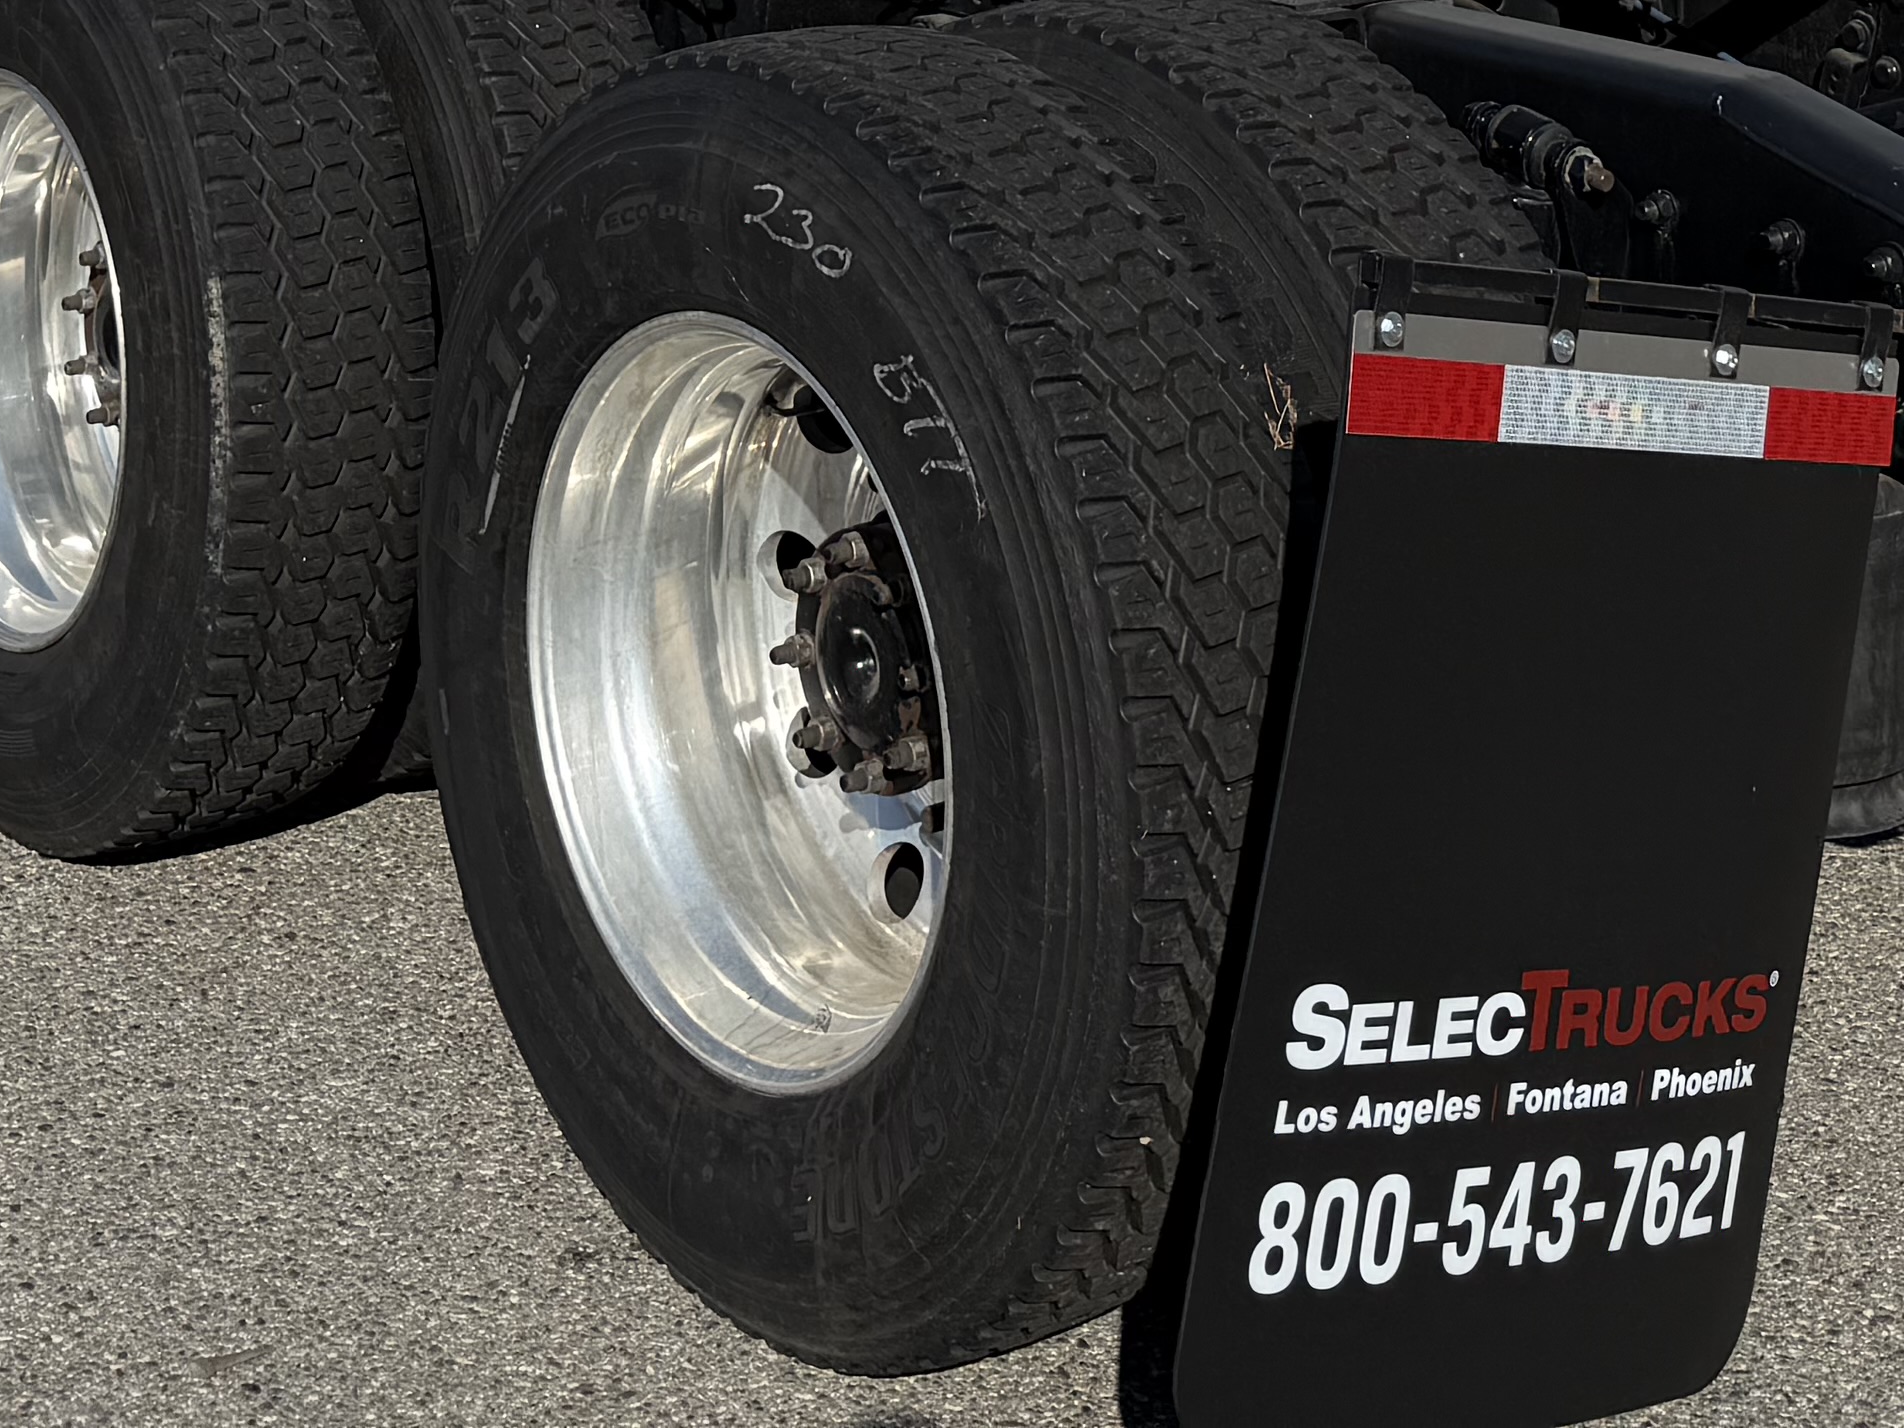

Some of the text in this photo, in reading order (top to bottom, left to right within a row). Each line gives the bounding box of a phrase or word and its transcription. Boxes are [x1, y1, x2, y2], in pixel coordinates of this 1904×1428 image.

[743, 181, 855, 280] 230
[1284, 968, 1770, 1071] SELECTRUCKS
[1273, 1058, 1757, 1136] Los Angeles Fontana Phoenix
[1247, 1130, 1747, 1296] 800-543-7621
